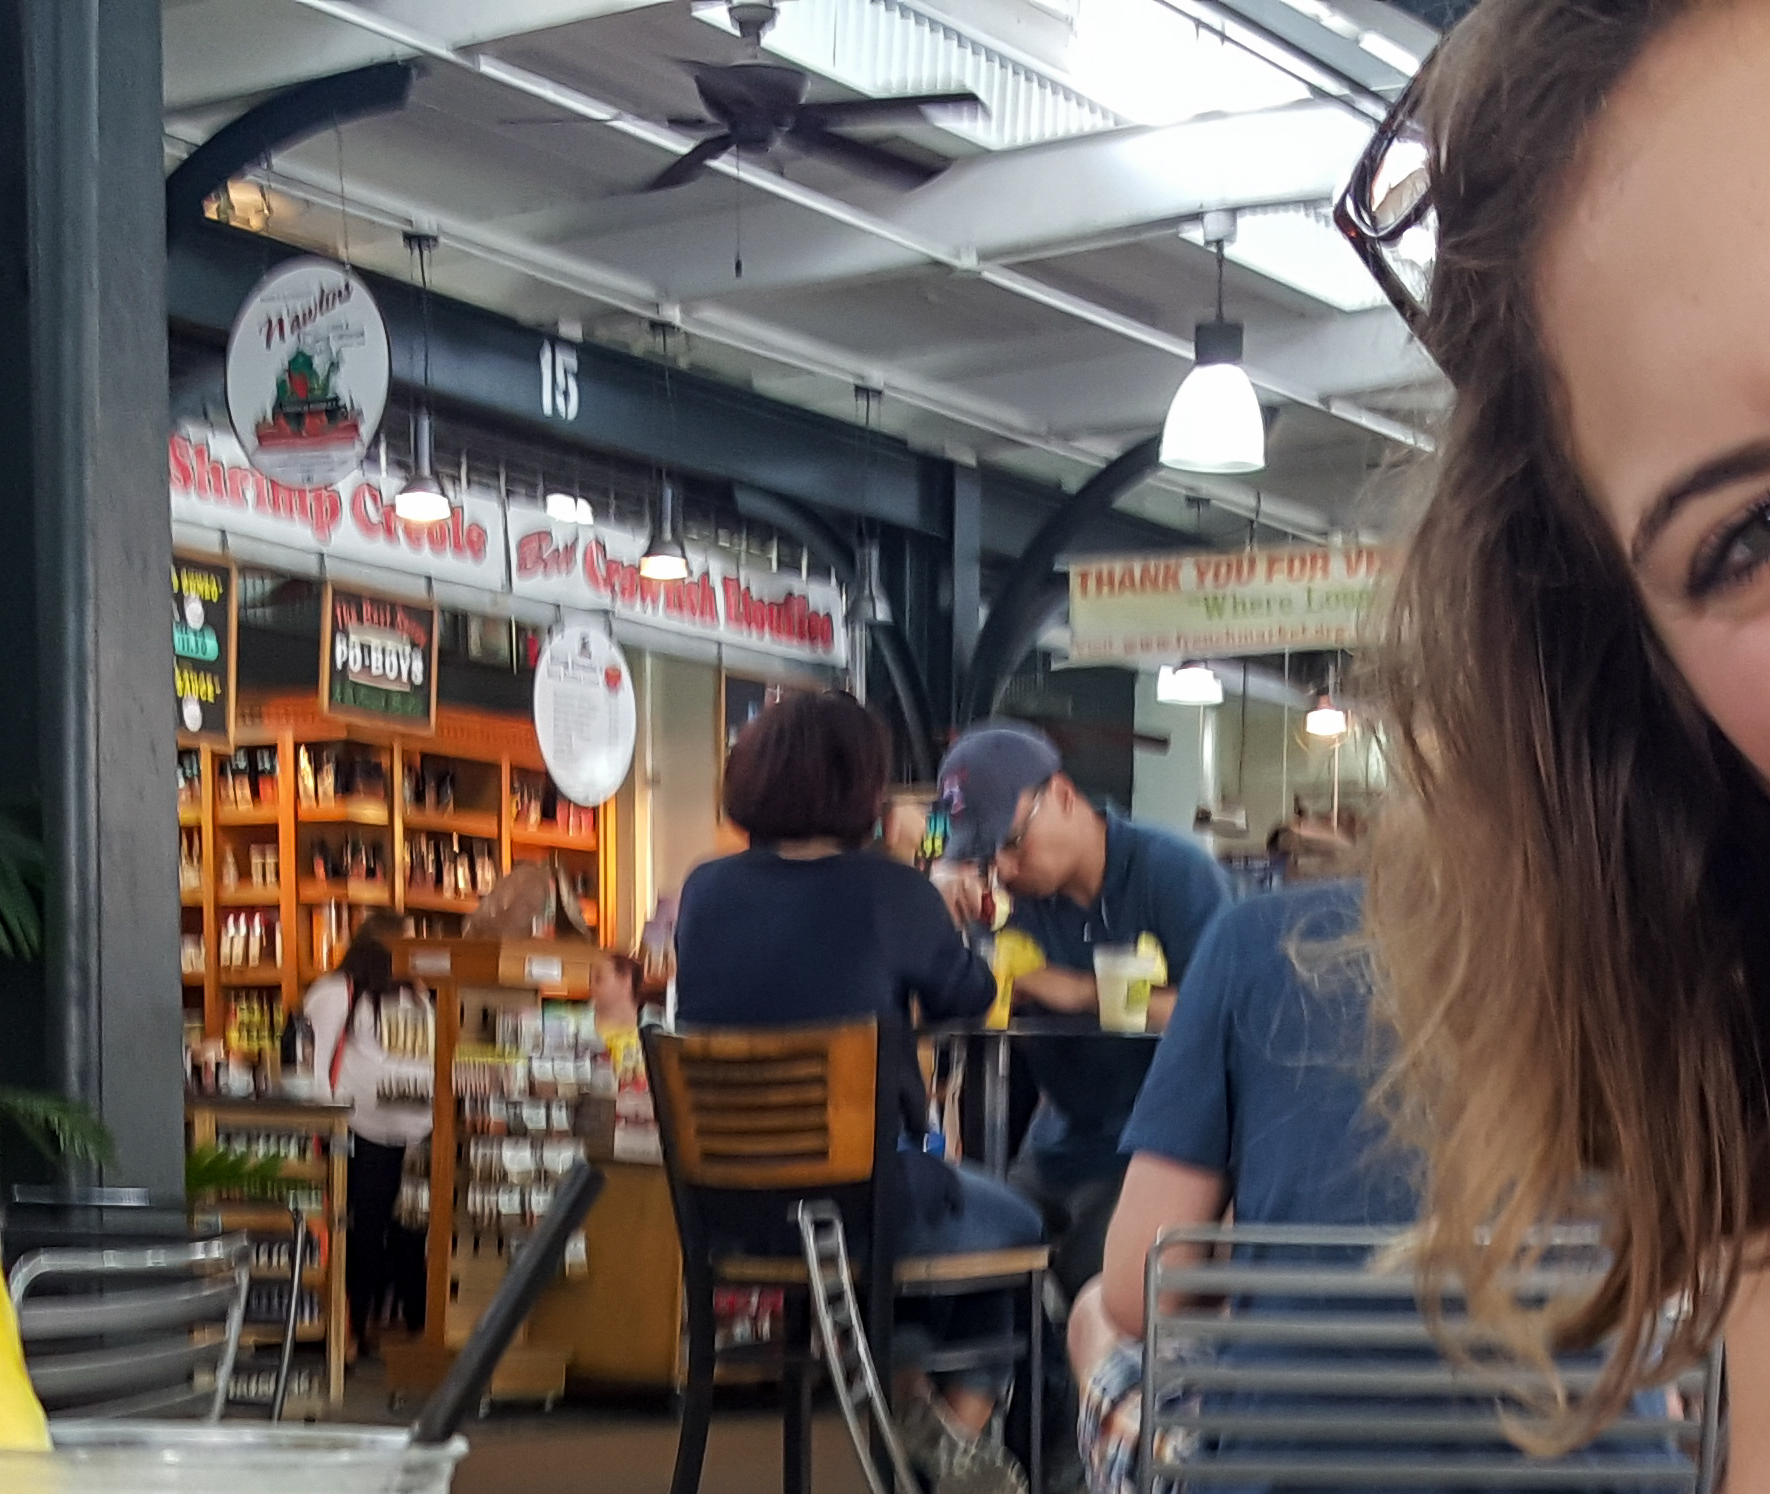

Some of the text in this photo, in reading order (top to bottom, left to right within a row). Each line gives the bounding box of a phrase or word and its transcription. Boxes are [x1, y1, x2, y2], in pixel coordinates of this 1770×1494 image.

[539, 340, 579, 421] 15
[170, 434, 342, 543] Shrimp
[1079, 560, 1181, 600] THANK
[1194, 554, 1258, 591] YOU
[1266, 550, 1331, 586] FOR
[1203, 586, 1293, 622] Where
